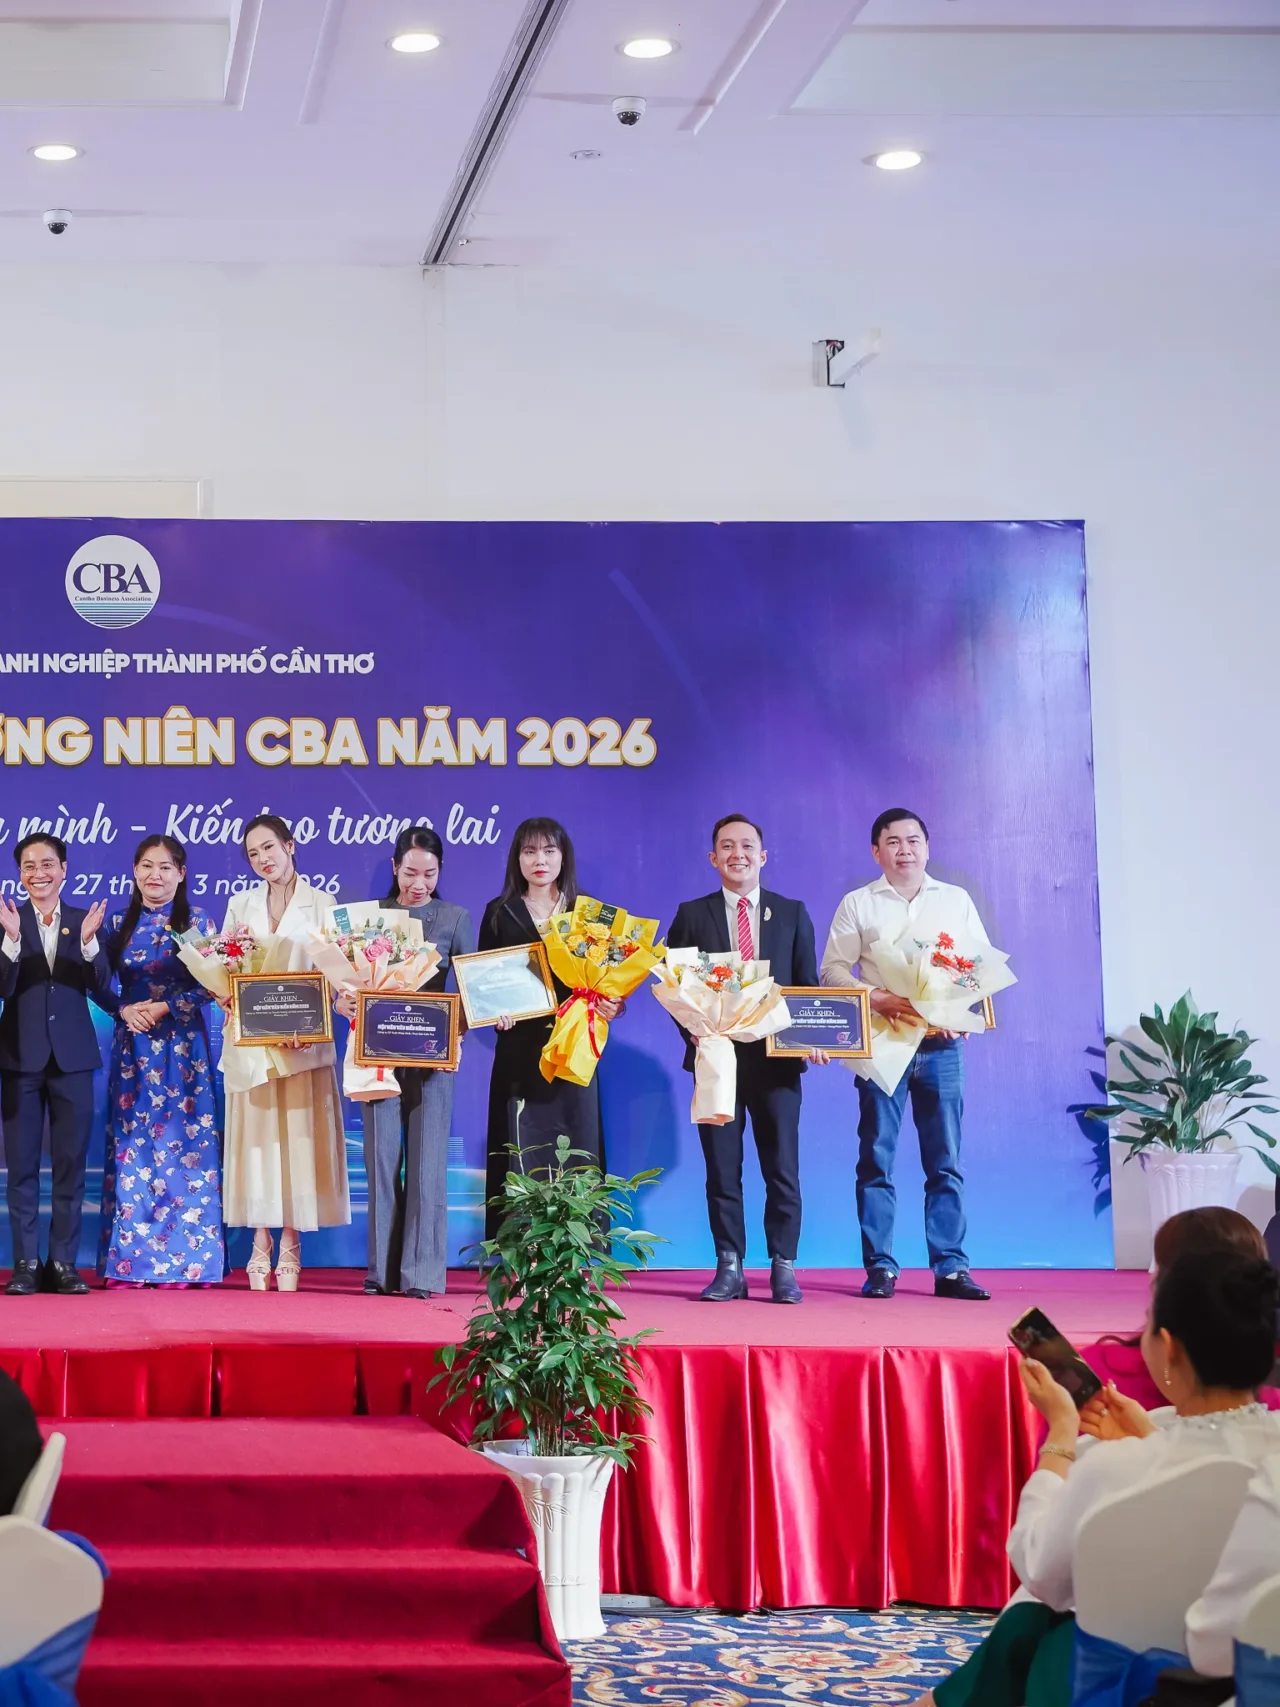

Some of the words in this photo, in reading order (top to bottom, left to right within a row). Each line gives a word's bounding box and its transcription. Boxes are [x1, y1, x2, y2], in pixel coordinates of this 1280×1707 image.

[72, 562, 154, 594] CBA
[43, 648, 131, 680] NGHIỆP
[132, 648, 213, 674] THÀNH
[216, 645, 268, 674] PHỐ
[270, 646, 321, 674] CẦN
[324, 652, 375, 674] THƠ
[103, 705, 236, 766] NIÊN
[245, 716, 369, 766] CBA
[377, 705, 508, 766] NĂM
[516, 716, 658, 767] 2026
[18, 802, 118, 845] mình
[165, 798, 244, 845] Kiến
[446, 802, 502, 845] lai
[72, 874, 103, 895] 27
[192, 874, 209, 895] 3
